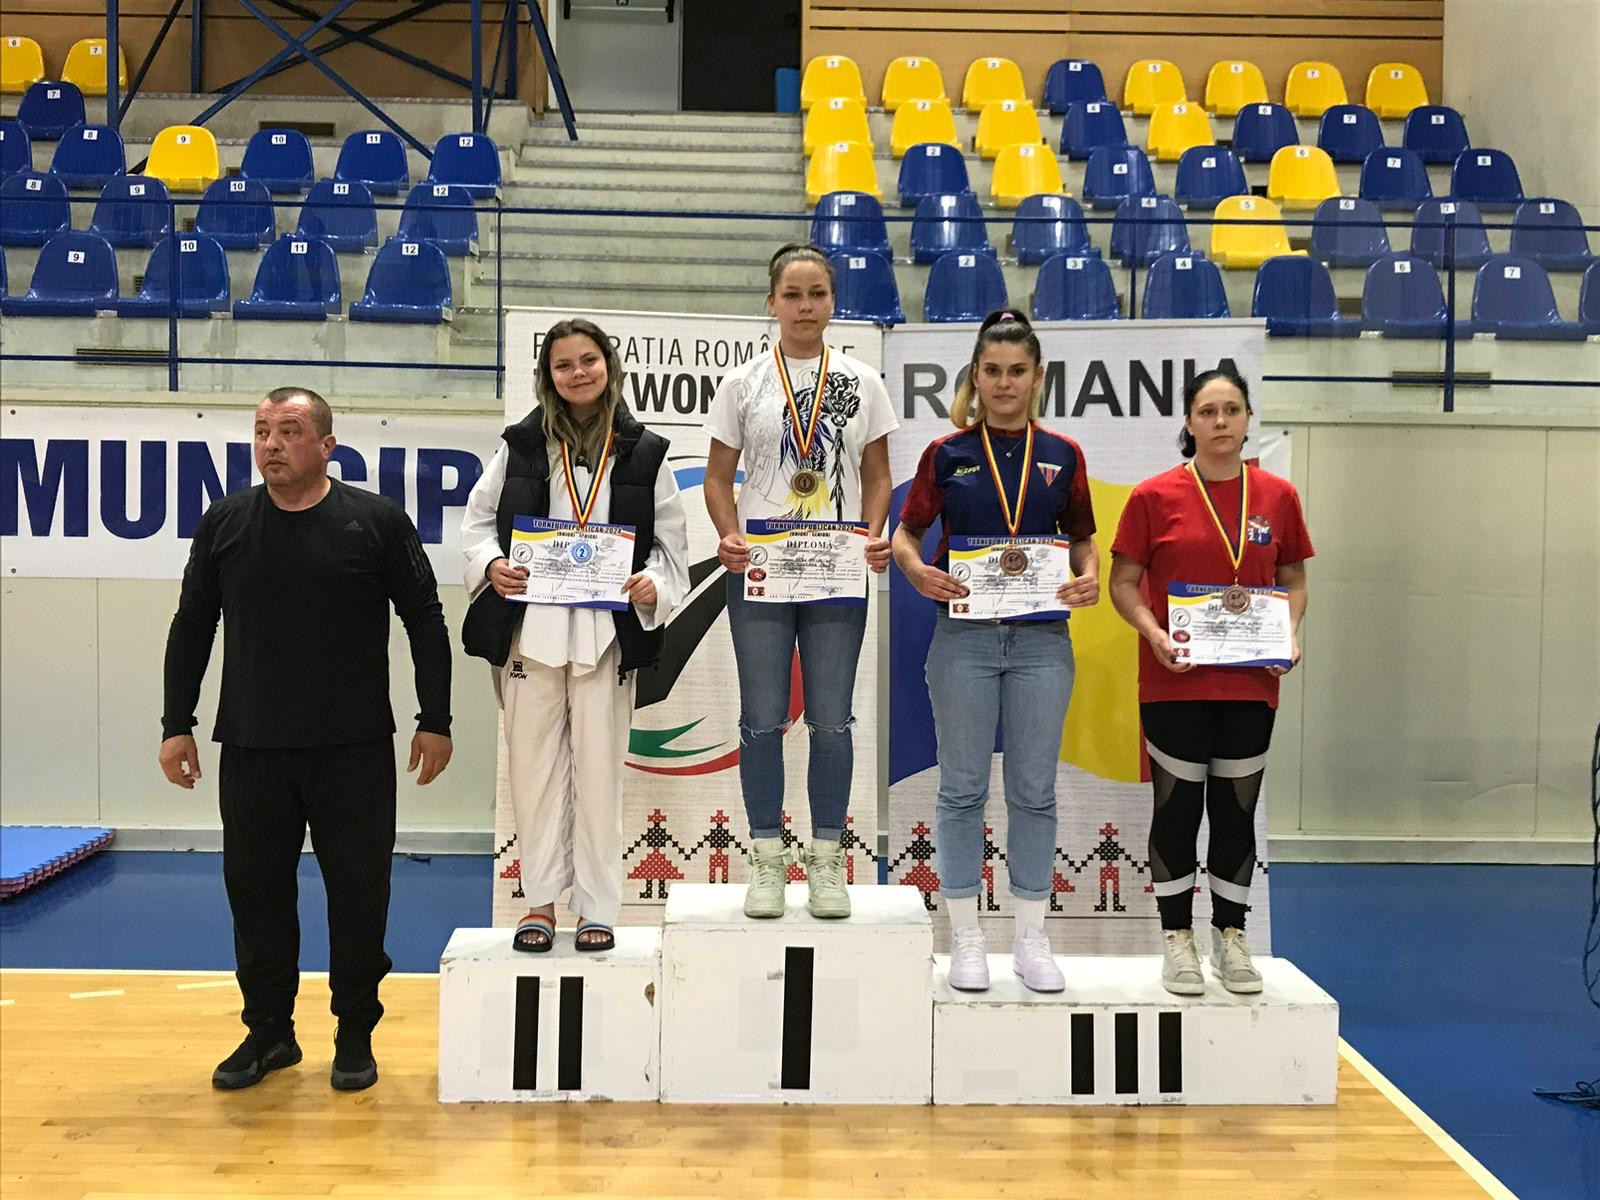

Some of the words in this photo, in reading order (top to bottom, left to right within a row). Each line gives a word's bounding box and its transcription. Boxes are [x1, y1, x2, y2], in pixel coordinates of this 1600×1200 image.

[1544, 204, 1550, 212] 8
[184, 242, 195, 250] 10
[295, 244, 304, 252] 11
[405, 246, 416, 254] 12
[73, 253, 80, 262] 9
[964, 258, 970, 266] 2
[1072, 260, 1078, 268] 3
[1399, 263, 1406, 272] 6
[1510, 268, 1515, 277] 7
[796, 522, 836, 530] REPUBLICAN
[580, 548, 585, 558] 2
